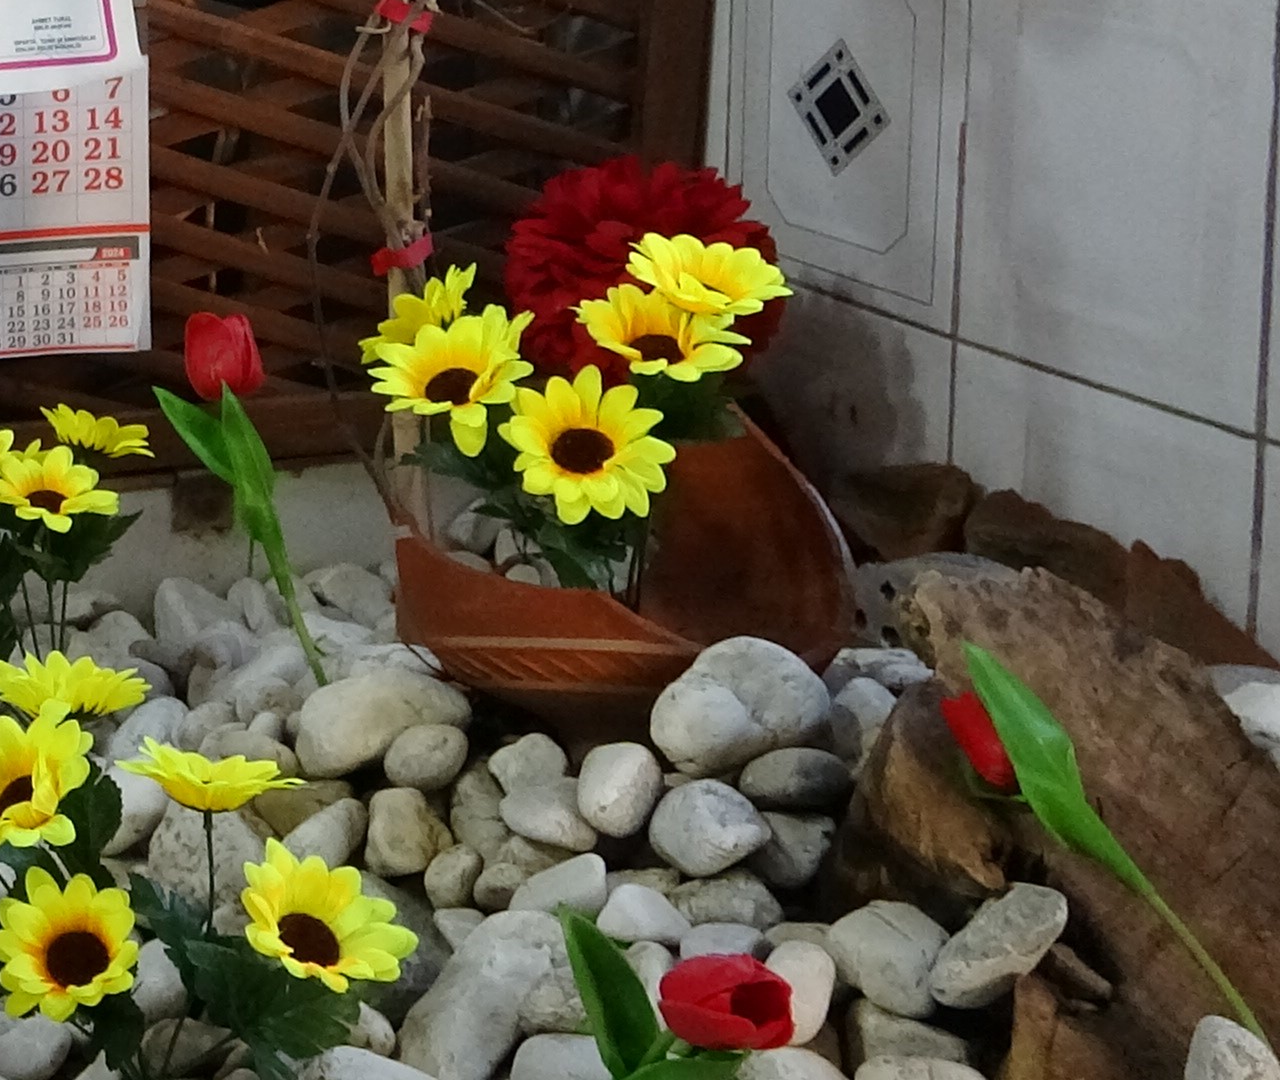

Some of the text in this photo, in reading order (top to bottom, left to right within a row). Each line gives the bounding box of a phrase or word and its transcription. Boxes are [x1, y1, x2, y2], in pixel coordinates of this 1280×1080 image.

[105, 77, 123, 99] 7
[35, 110, 69, 134] 13
[87, 107, 123, 130] 14
[32, 140, 69, 164] 20
[85, 137, 120, 160] 21
[32, 170, 69, 194] 27
[85, 167, 123, 190] 28
[18, 269, 126, 287] 1 2 3 4 5
[17, 290, 24, 303] 8
[42, 289, 50, 301] 9
[60, 288, 75, 299] 10
[85, 286, 99, 298] 11
[110, 285, 126, 297] 12
[9, 305, 25, 318] 15
[34, 304, 50, 316] 16
[59, 302, 75, 314] 17
[85, 301, 101, 313] 18
[111, 300, 127, 312] 19
[7, 321, 25, 333] 22
[33, 319, 50, 331] 23
[58, 317, 75, 329] 24
[83, 316, 101, 328] 25
[109, 315, 128, 327] 26
[8, 336, 26, 350] 29
[33, 334, 50, 347] 30
[58, 332, 74, 345] 31
